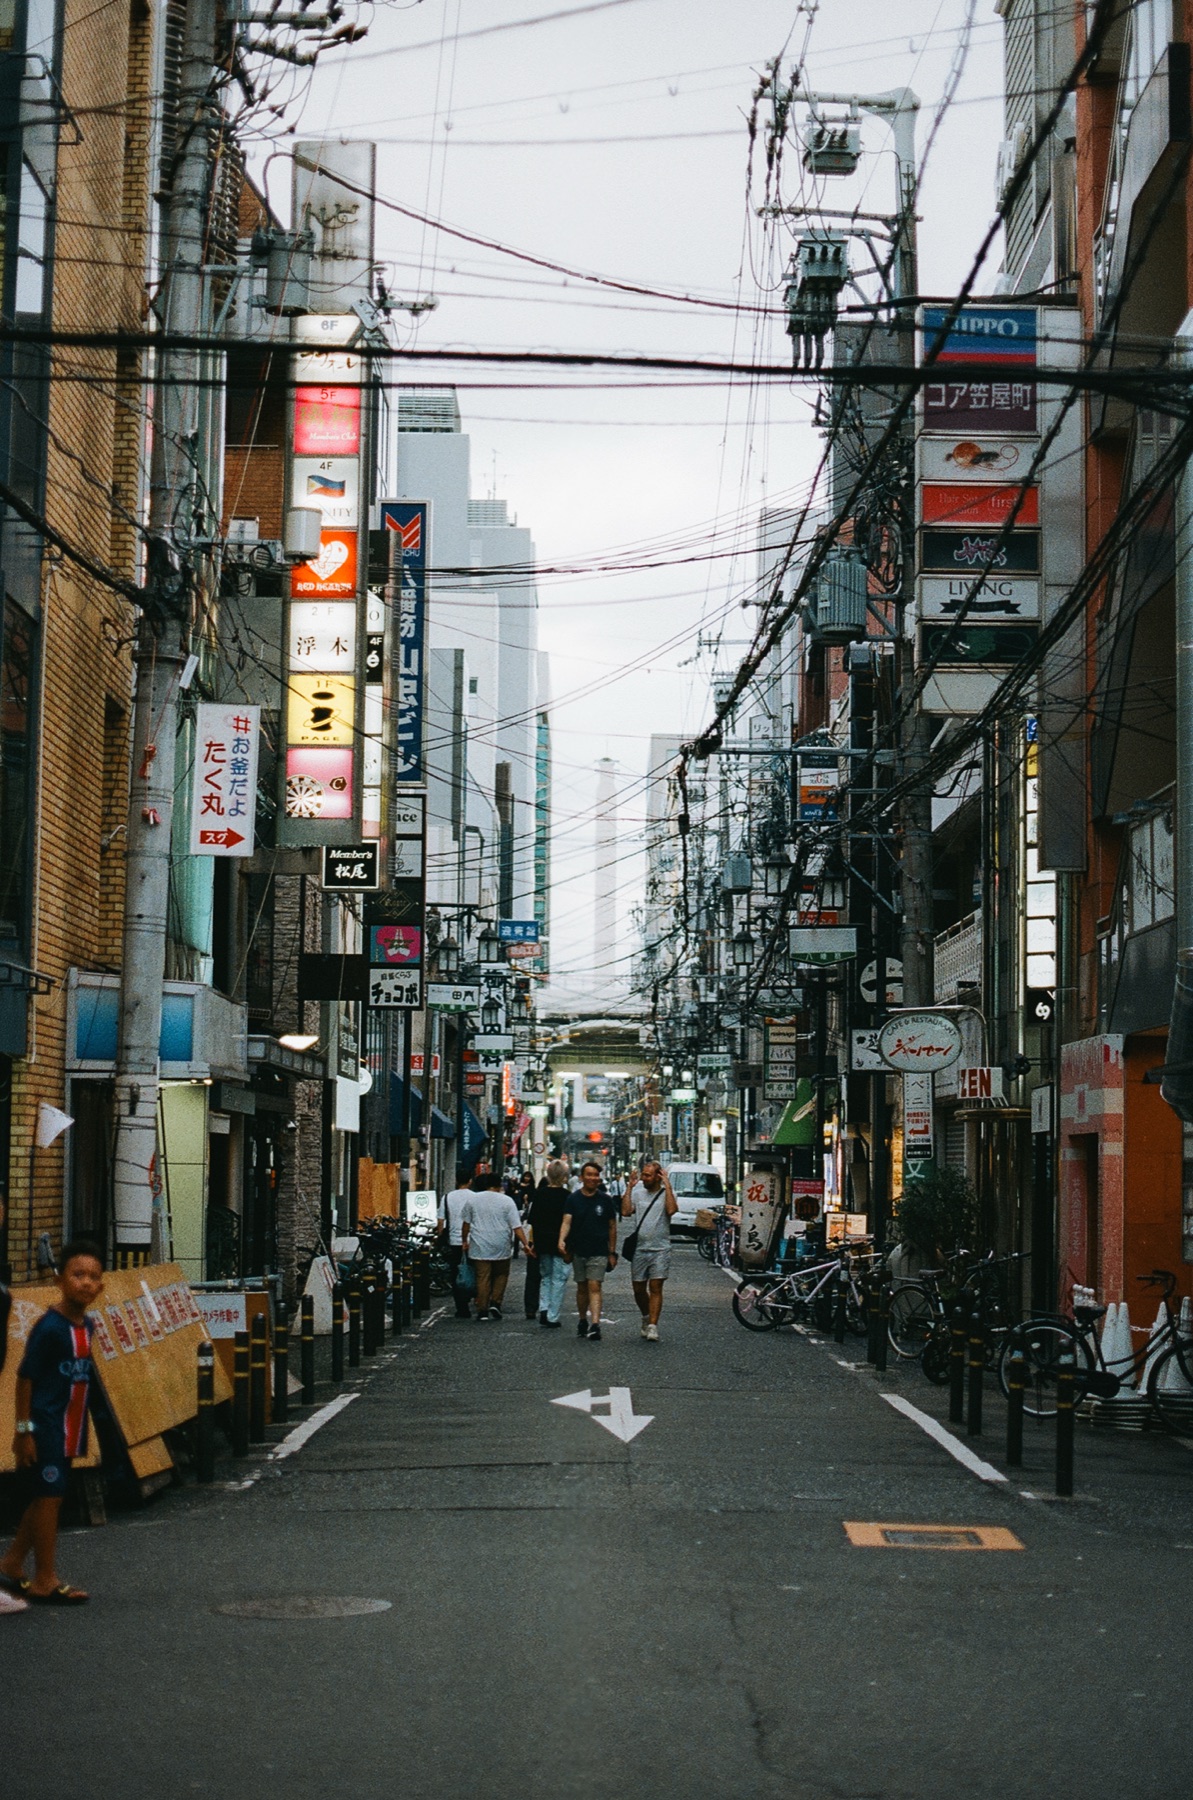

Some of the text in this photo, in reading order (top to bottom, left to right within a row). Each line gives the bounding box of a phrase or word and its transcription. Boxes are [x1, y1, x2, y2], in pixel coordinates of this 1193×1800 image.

[321, 319, 339, 331] 6F
[942, 317, 1019, 338] IPPO
[320, 388, 337, 400] 5F
[928, 382, 1032, 411] コア笠屋町
[319, 461, 333, 470] 4F
[370, 637, 382, 645] 4F
[201, 740, 227, 816] たく丸
[205, 832, 228, 843] スグ
[329, 850, 373, 859] Member's
[335, 863, 368, 879] 松尾
[372, 983, 419, 1004] チョコボ
[886, 1021, 903, 1036] CAFE
